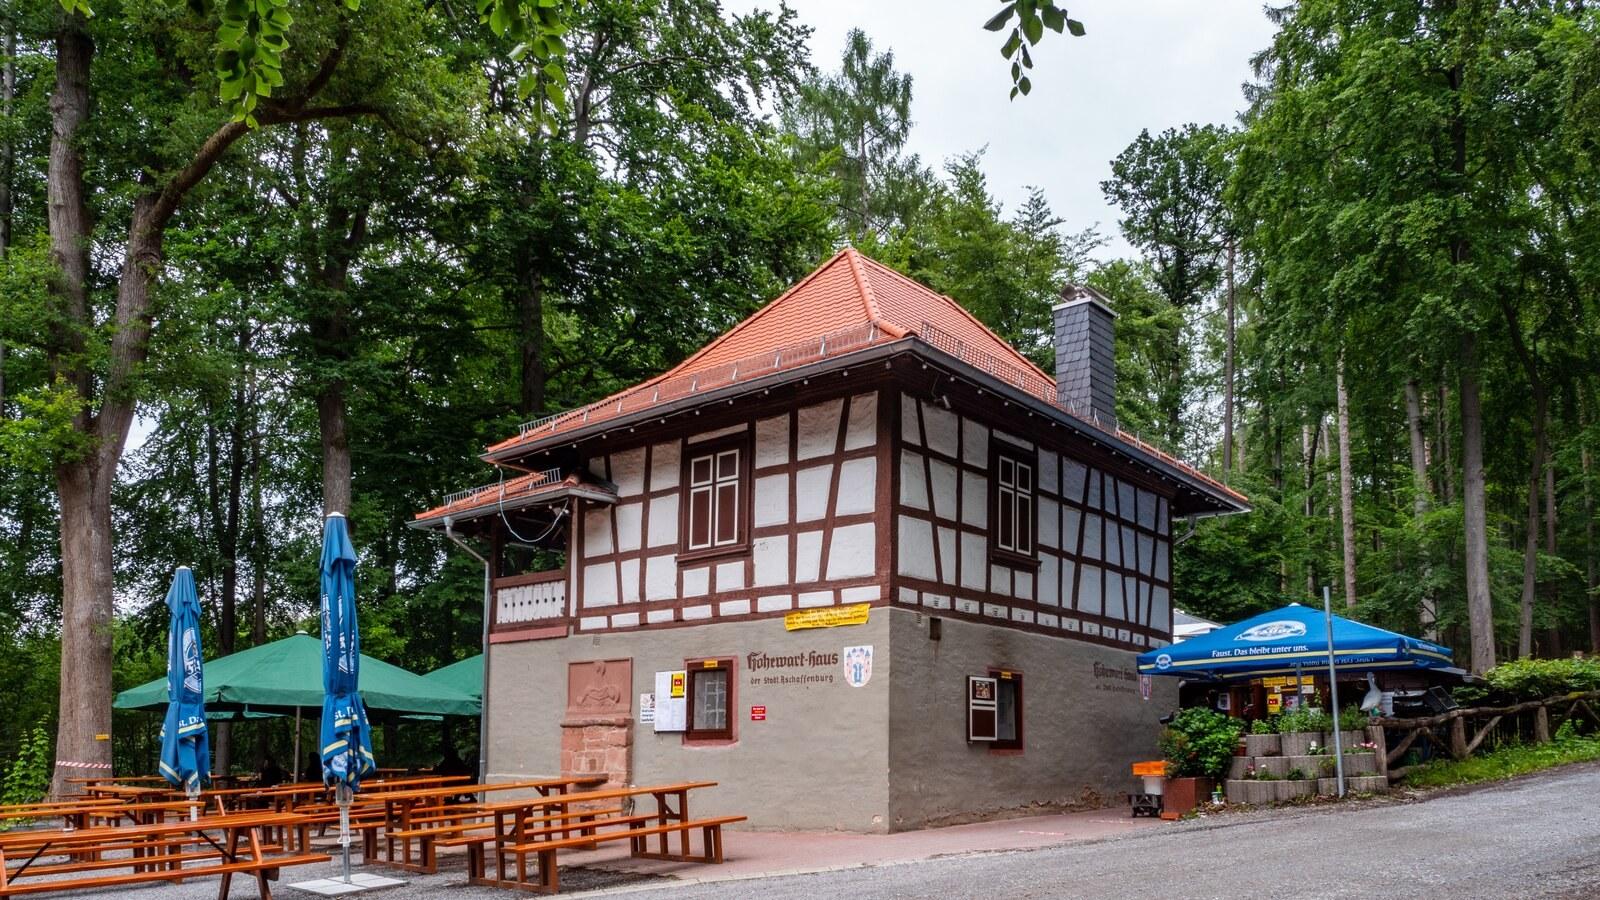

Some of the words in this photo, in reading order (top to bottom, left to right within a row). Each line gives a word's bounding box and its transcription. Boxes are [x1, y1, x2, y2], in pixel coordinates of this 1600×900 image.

[1234, 648, 1248, 656] Das
[1249, 646, 1270, 655] bleibt
[1271, 645, 1292, 653] unter
[1293, 644, 1309, 652] uns.
[750, 676, 761, 685] der
[763, 675, 779, 685] Stadt
[780, 674, 834, 686] Aschaffenburg
